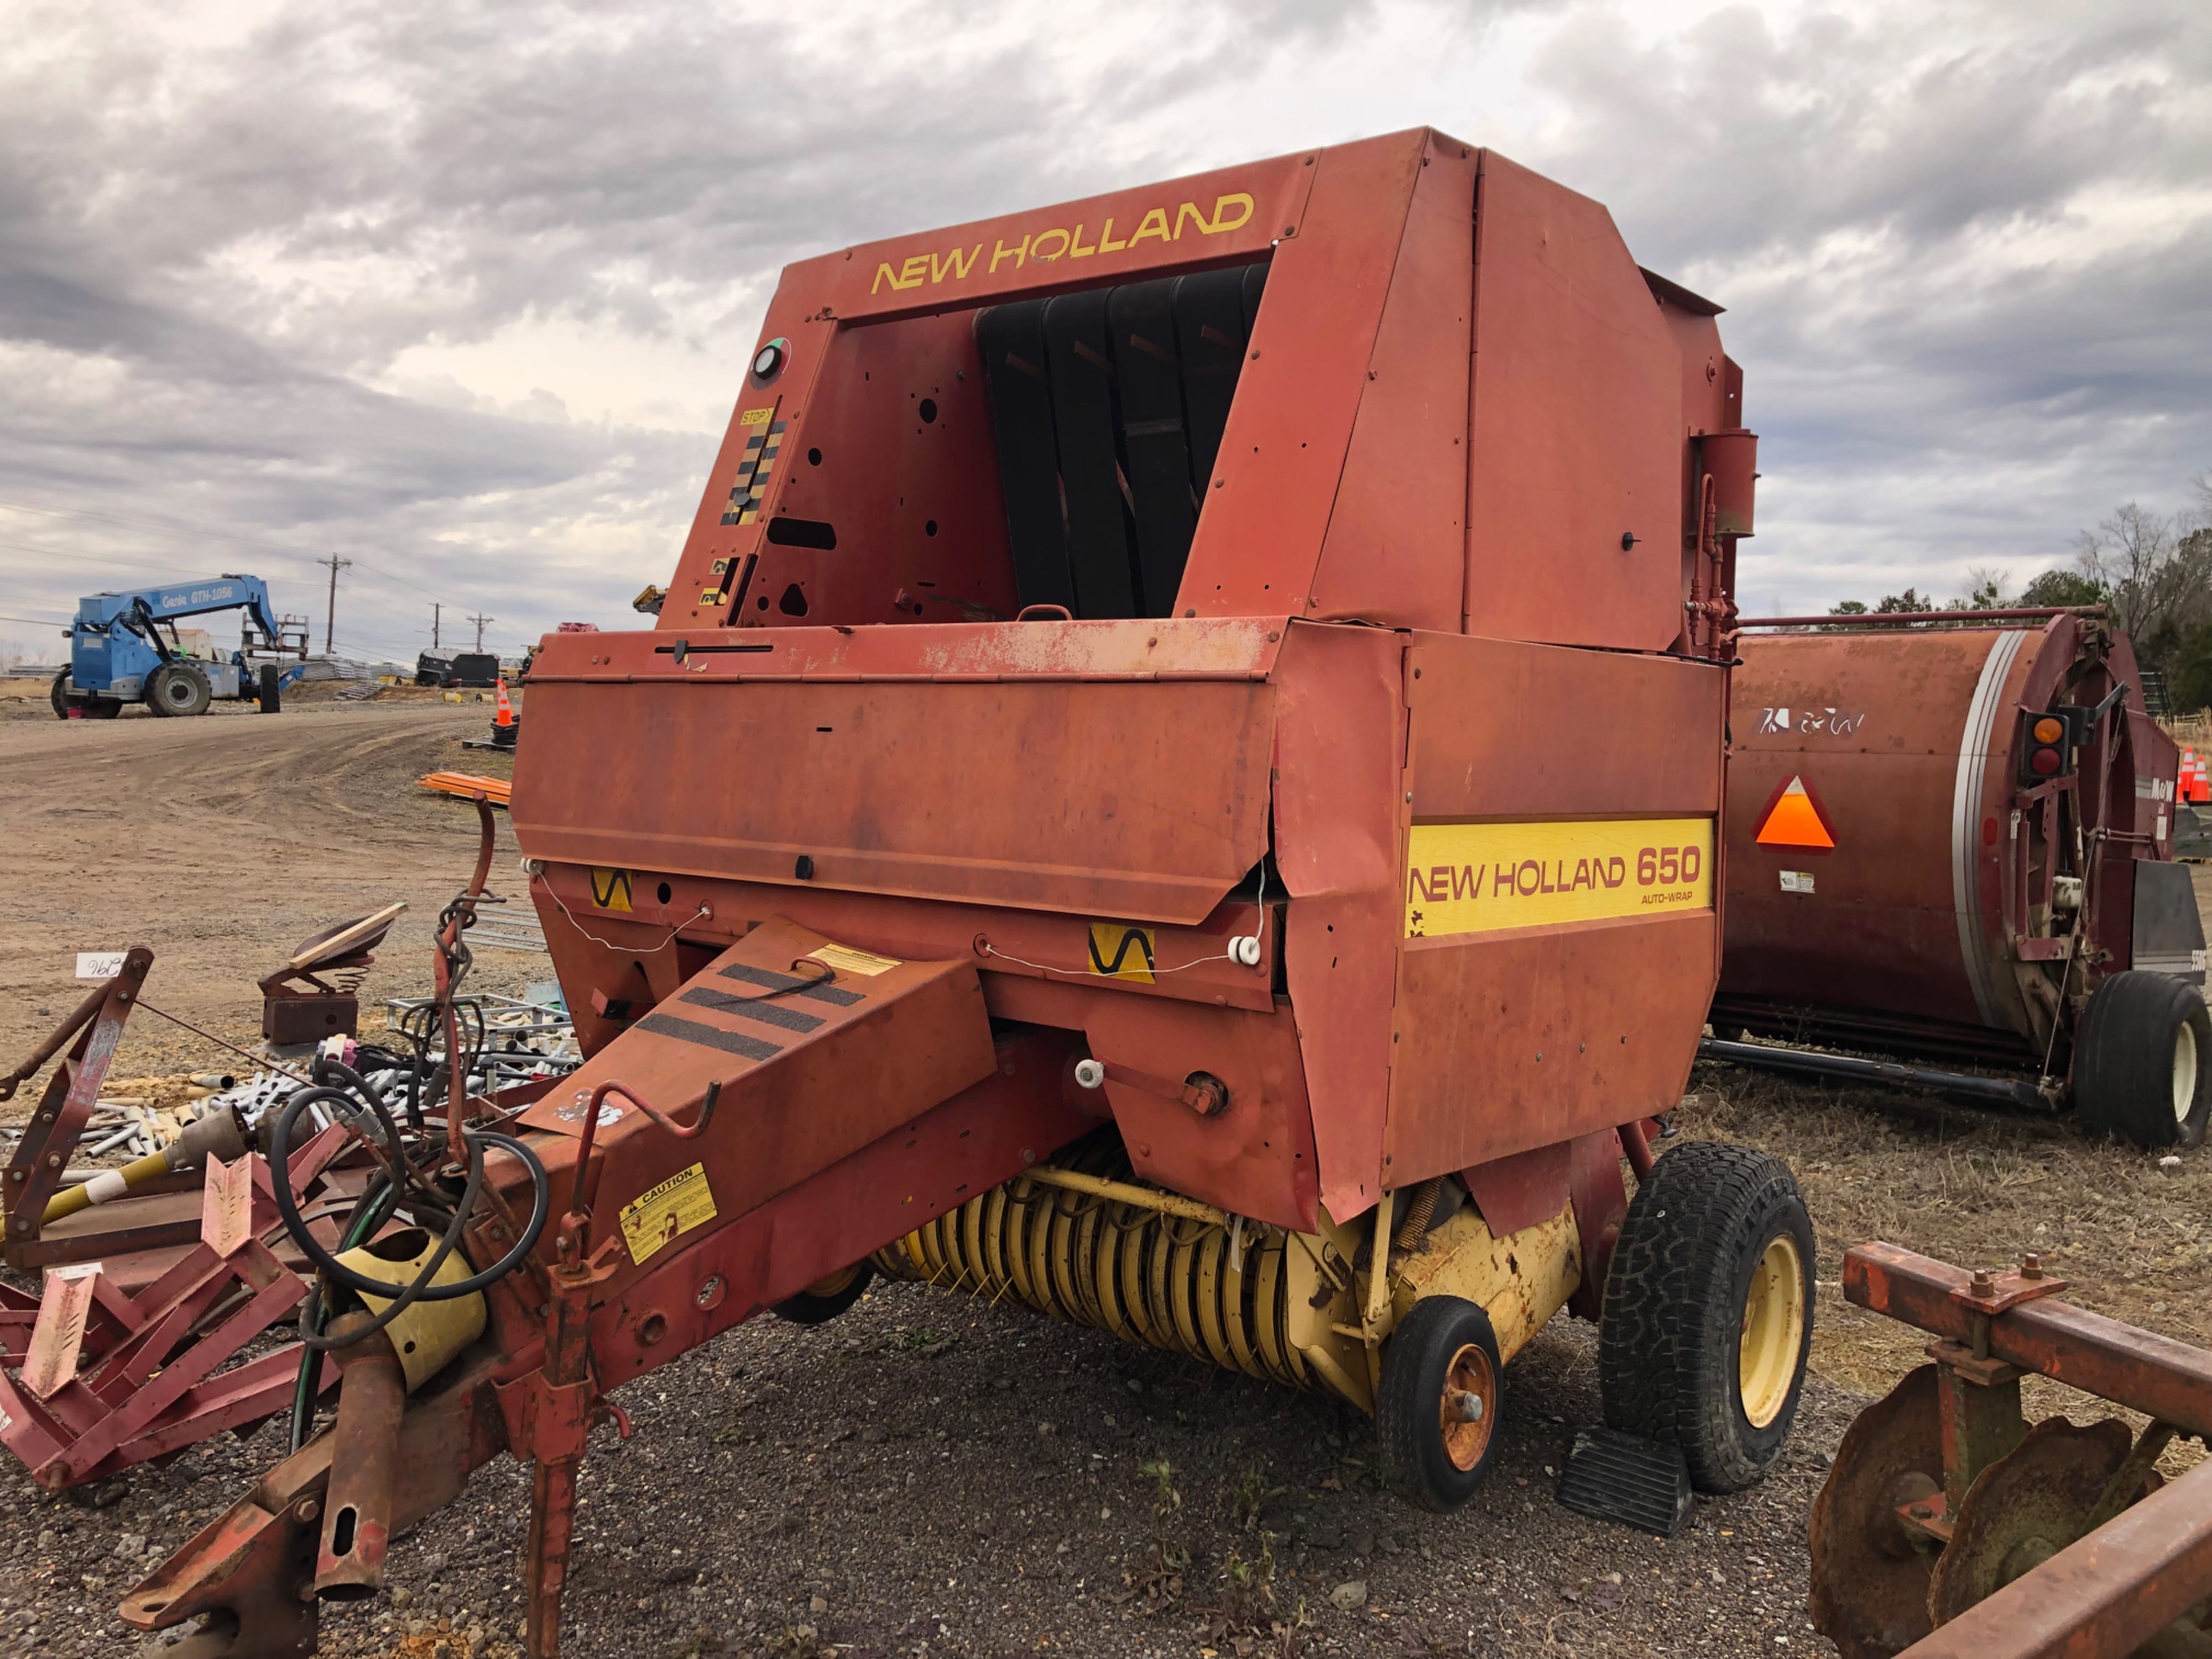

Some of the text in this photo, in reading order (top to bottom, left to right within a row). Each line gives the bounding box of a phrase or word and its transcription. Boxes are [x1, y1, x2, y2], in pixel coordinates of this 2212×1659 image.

[871, 192, 1255, 295] NEW HOLLAND
[742, 410, 766, 424] STOP
[162, 594, 187, 609] Genie
[1408, 846, 1700, 904] NEW HOLLAND 650
[1641, 891, 1693, 905] AUTO-WRAP
[642, 1168, 693, 1203] CAUTION
